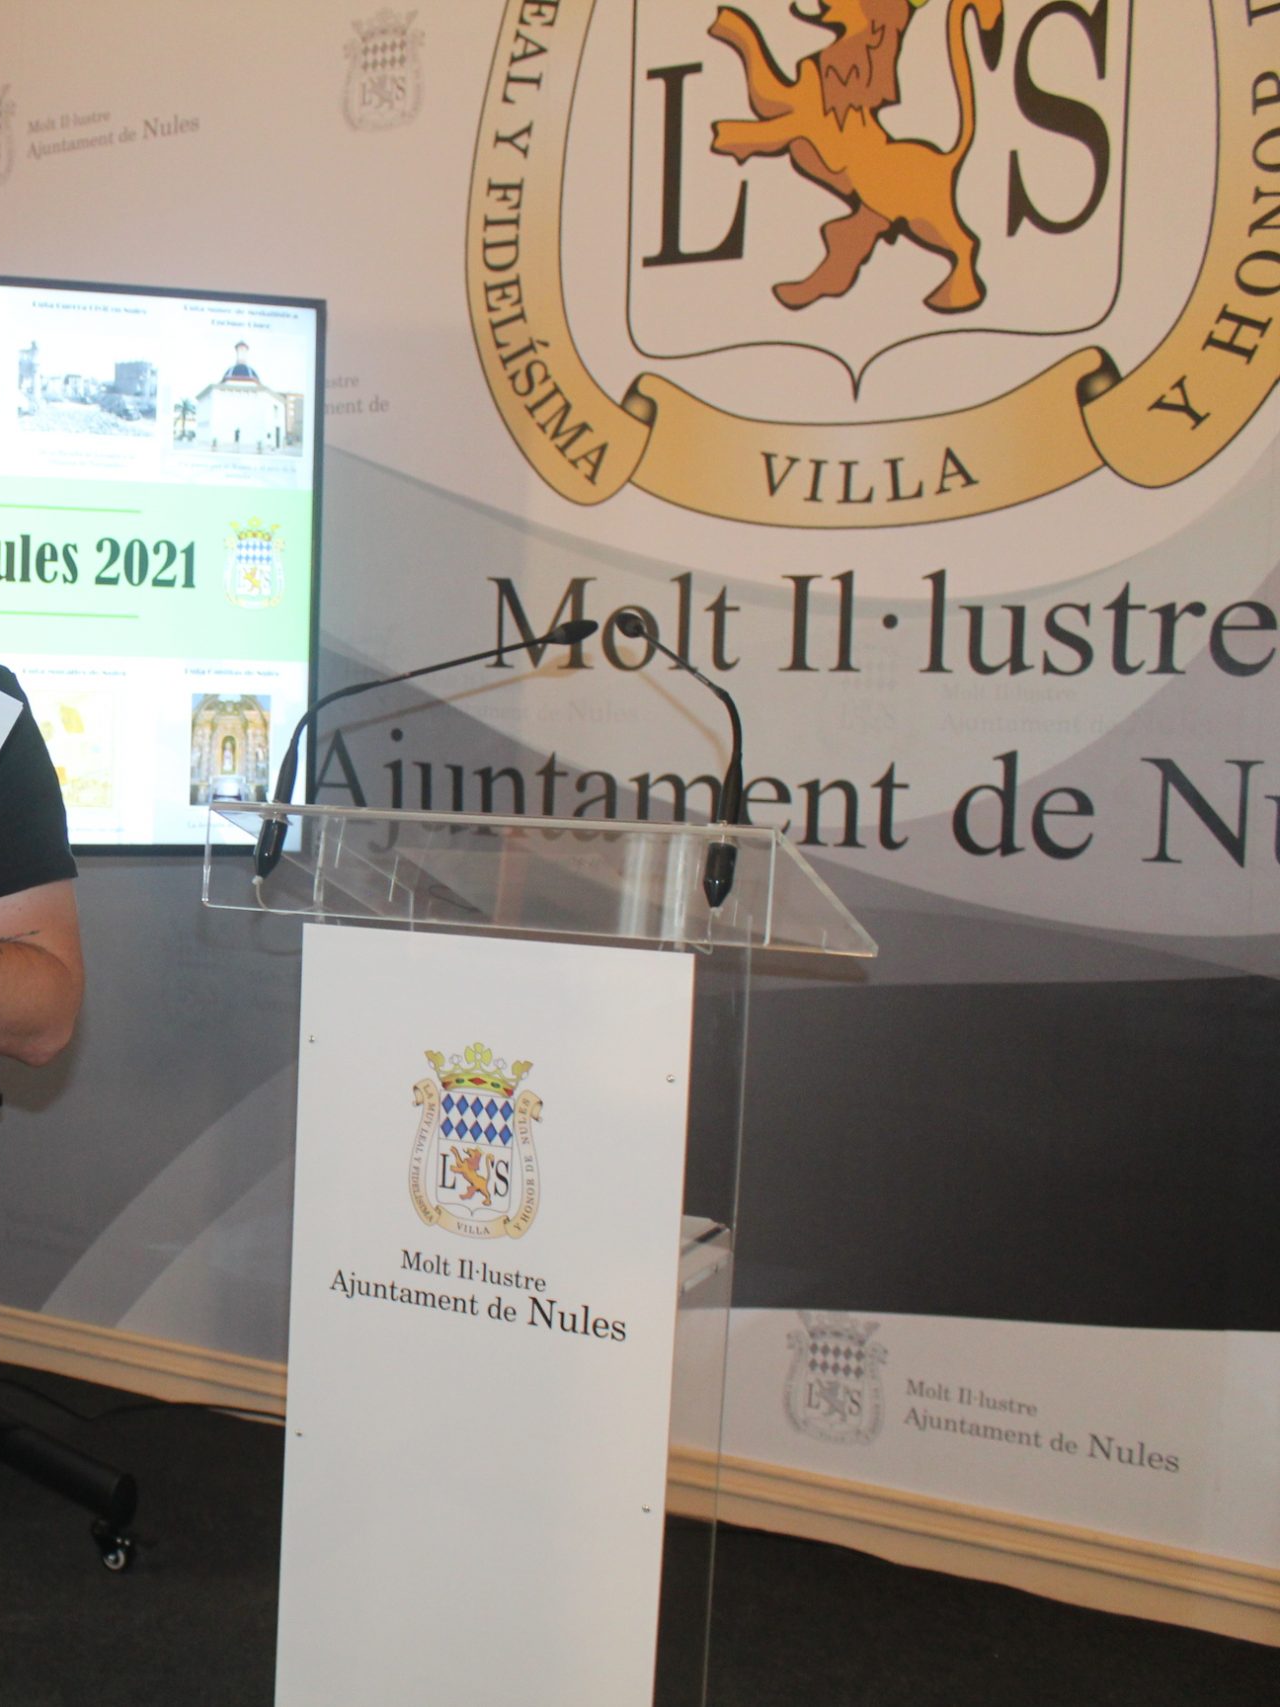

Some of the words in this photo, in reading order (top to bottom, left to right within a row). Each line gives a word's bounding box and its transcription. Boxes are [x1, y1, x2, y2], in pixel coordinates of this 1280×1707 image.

[26, 129, 115, 160] Ajuntament
[118, 125, 137, 144] de
[142, 113, 201, 140] Nules
[494, 121, 533, 158] Y
[642, 62, 748, 268] L
[482, 178, 610, 485] FIDELÍSIMA
[1147, 376, 1210, 431] Y
[760, 447, 979, 505] VILLA
[95, 536, 198, 590] 2021
[485, 570, 740, 673] Molt
[307, 728, 910, 854] Ajuntament
[952, 749, 1095, 861] de
[524, 1154, 535, 1173] DE
[456, 1221, 491, 1236] VILLA
[519, 1179, 536, 1224] HONOR
[400, 1249, 451, 1280] Molt
[330, 1268, 480, 1318] Ajuntament
[487, 1296, 518, 1323] de
[526, 1295, 628, 1343] Nules
[906, 1377, 951, 1404] Molt
[903, 1405, 1043, 1451] Ajuntament
[1049, 1432, 1079, 1456] de
[1087, 1432, 1182, 1474] Nules
